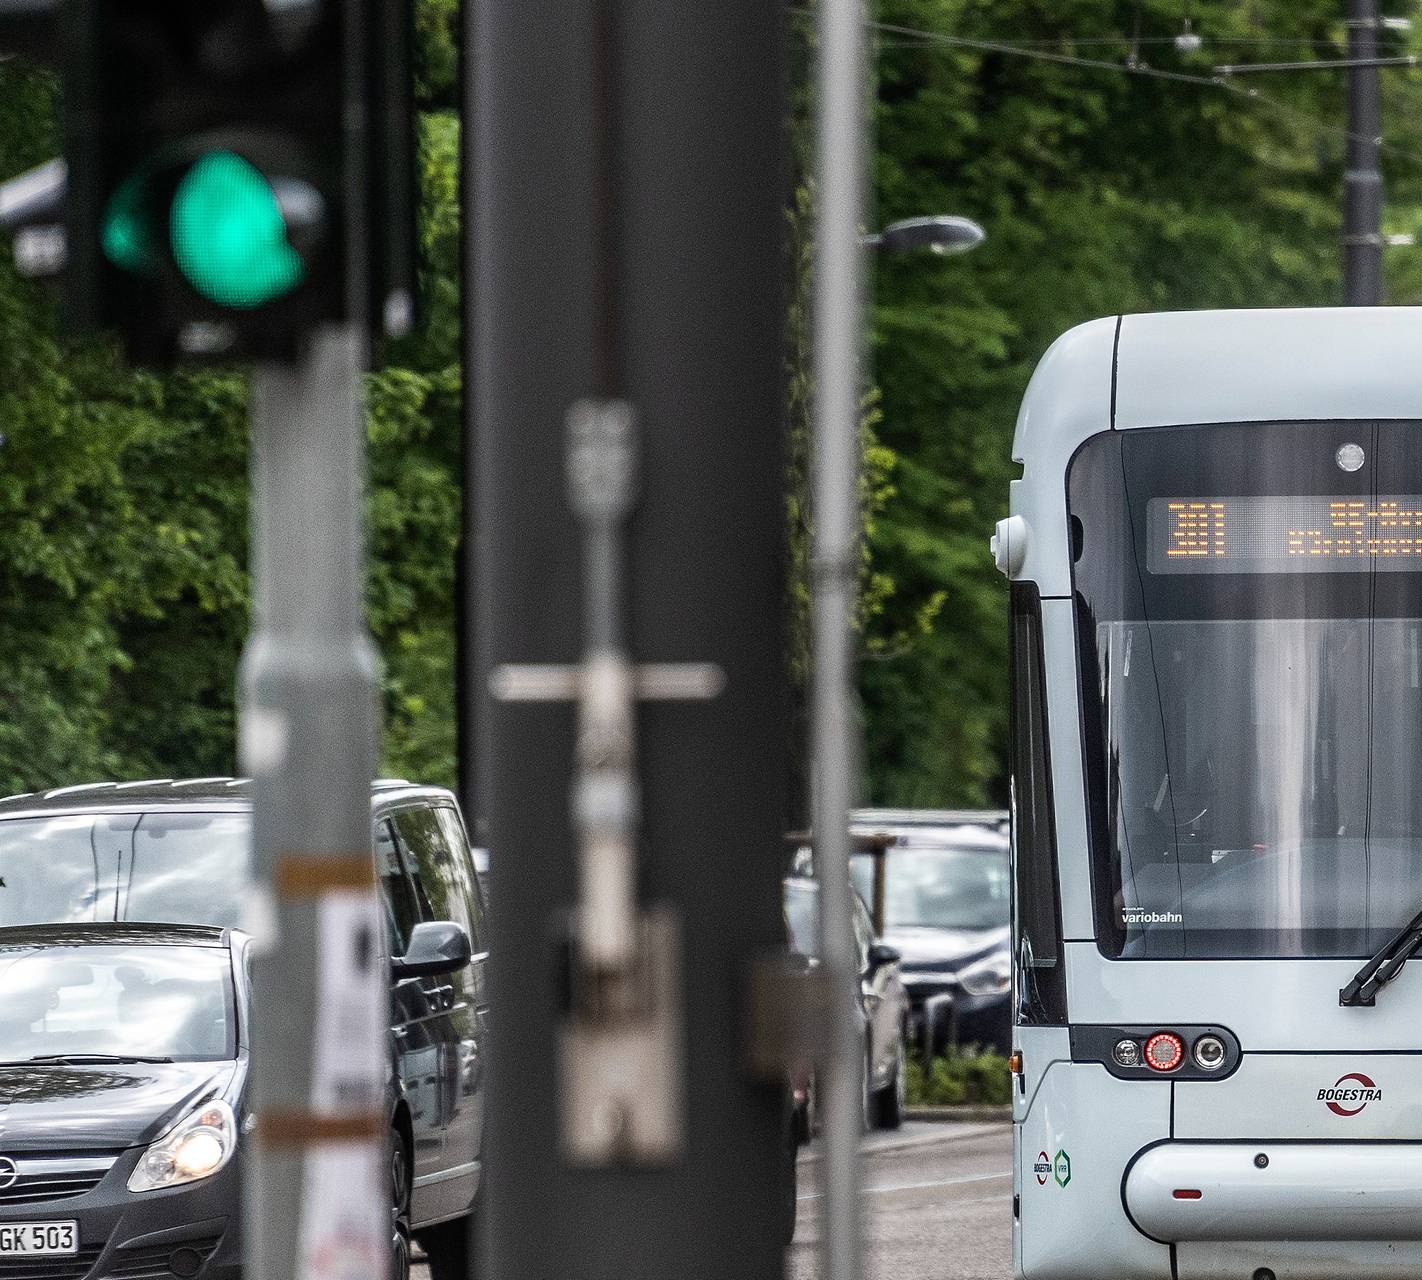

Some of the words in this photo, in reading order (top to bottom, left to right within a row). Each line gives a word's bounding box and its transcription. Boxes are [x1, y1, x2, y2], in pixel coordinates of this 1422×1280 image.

[1121, 912, 1183, 923] variobahn
[1316, 1088, 1382, 1101] BOGESTRA
[32, 1225, 73, 1250] 503
